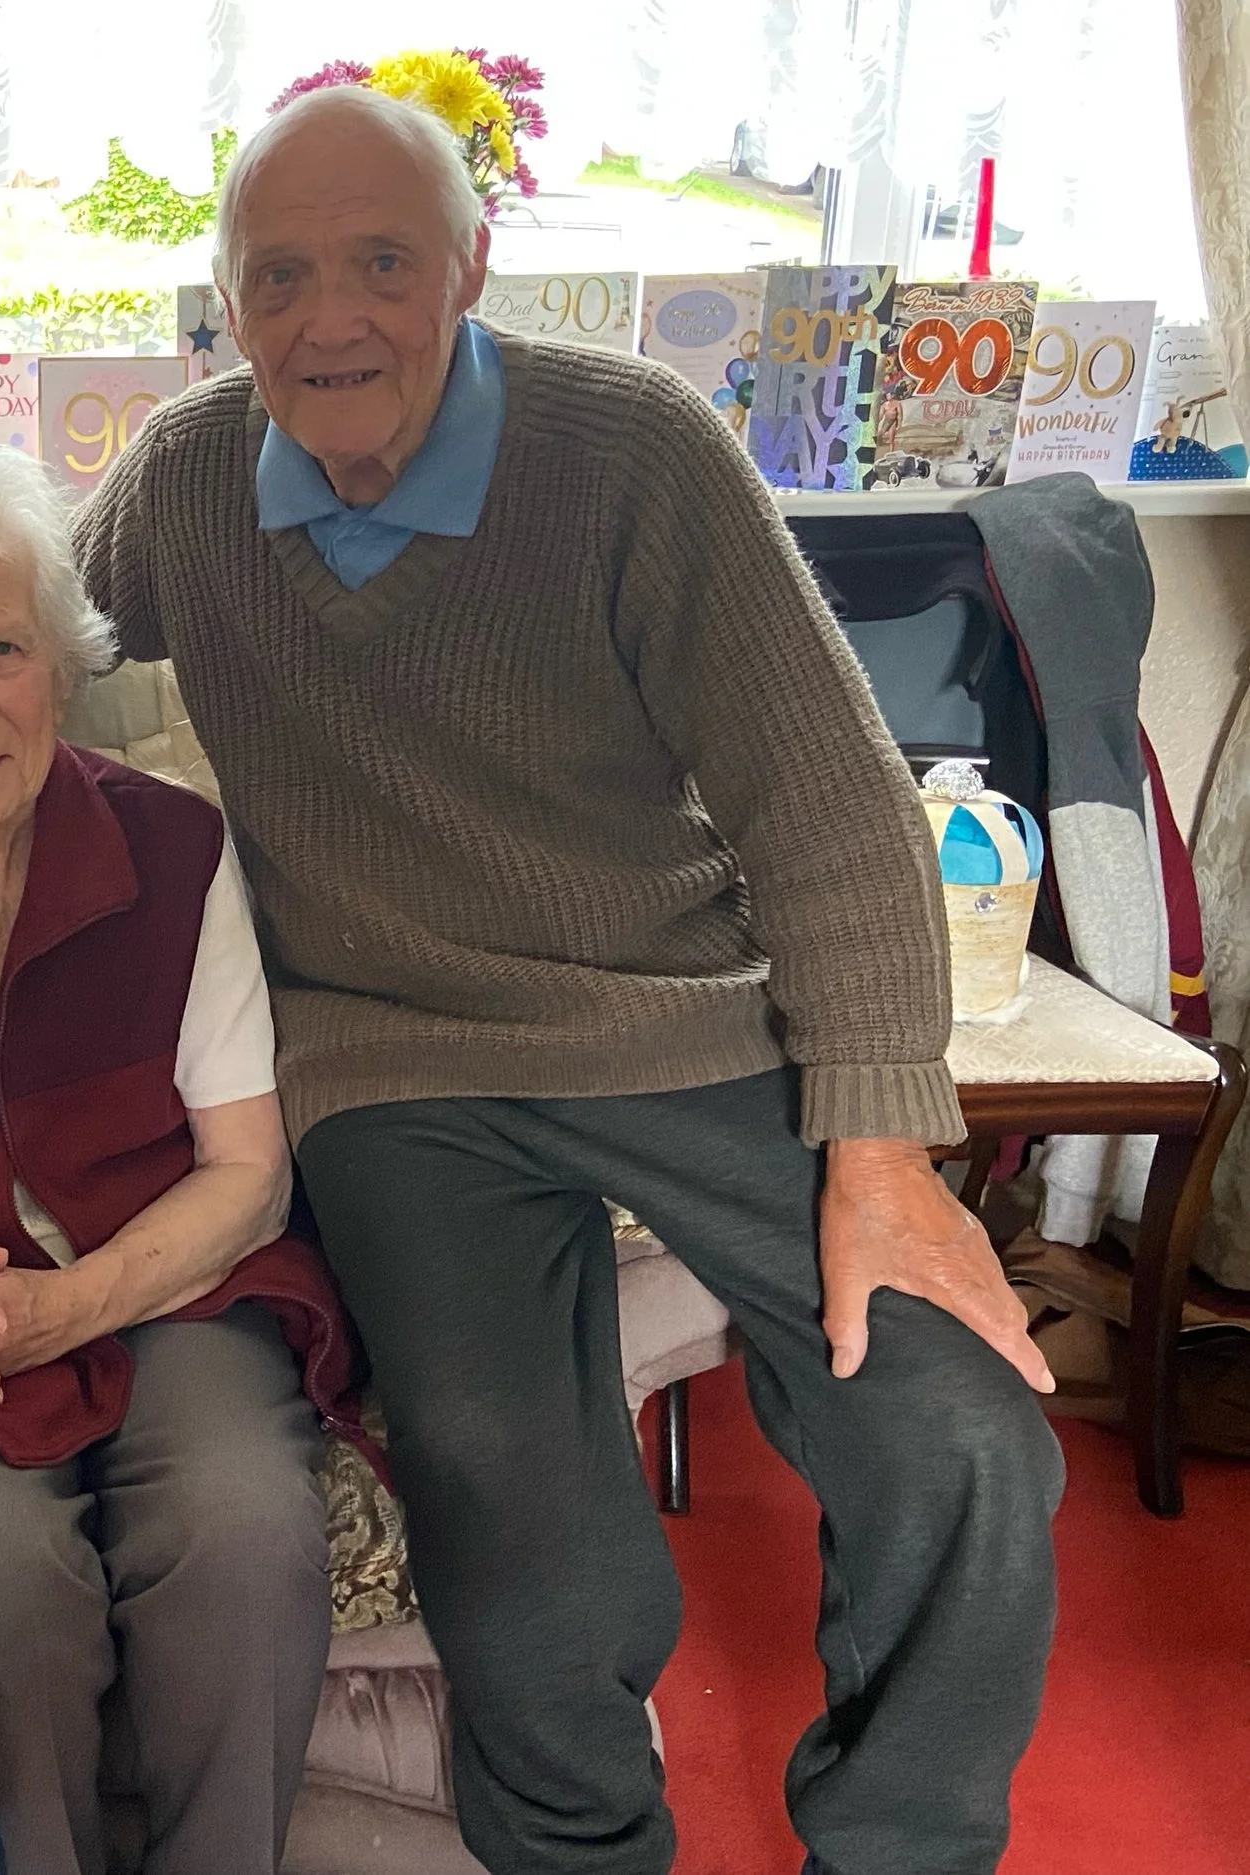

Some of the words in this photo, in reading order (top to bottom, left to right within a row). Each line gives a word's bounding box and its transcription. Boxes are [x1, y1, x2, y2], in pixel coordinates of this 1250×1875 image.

[484, 294, 538, 318] Dad
[538, 276, 610, 333] 90
[903, 286, 949, 312] Born
[949, 299, 967, 312] in
[967, 286, 1026, 313] 1932
[767, 305, 879, 367] 90th
[899, 317, 1014, 397] 90
[1025, 325, 1136, 406] 90
[64, 391, 161, 473] 90
[922, 399, 975, 422] TODAY
[1018, 451, 1053, 463] HAPPY
